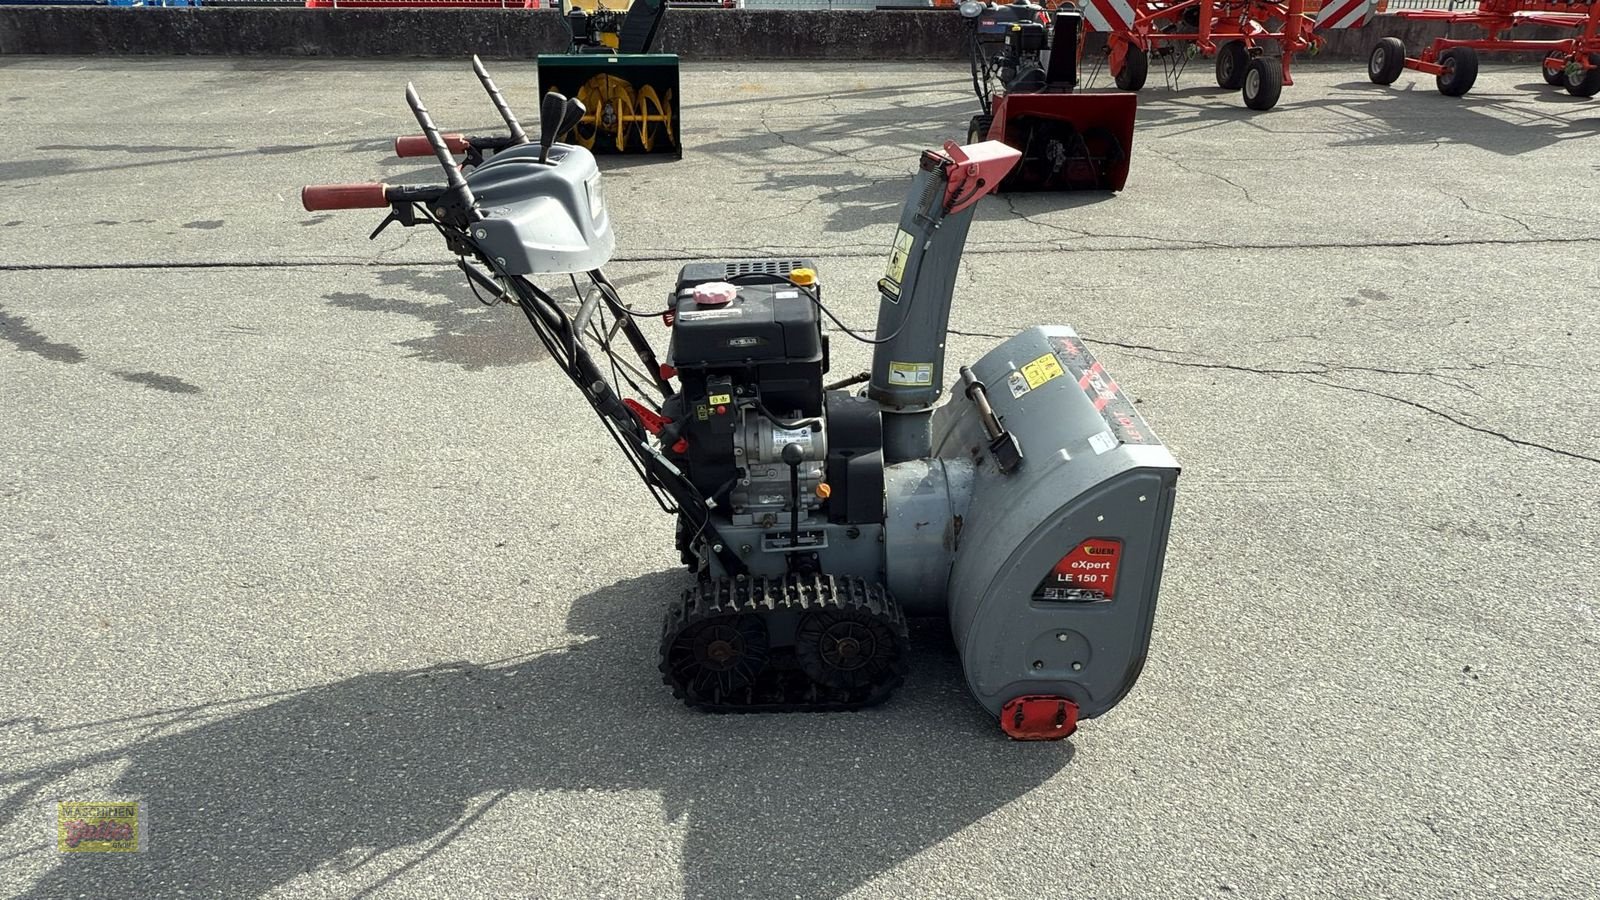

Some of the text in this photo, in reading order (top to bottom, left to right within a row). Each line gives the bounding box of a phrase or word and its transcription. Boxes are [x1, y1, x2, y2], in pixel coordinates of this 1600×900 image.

[1089, 547, 1114, 555] GUEM
[1071, 560, 1111, 570] eXpert
[1057, 573, 1109, 583] LE 150 T
